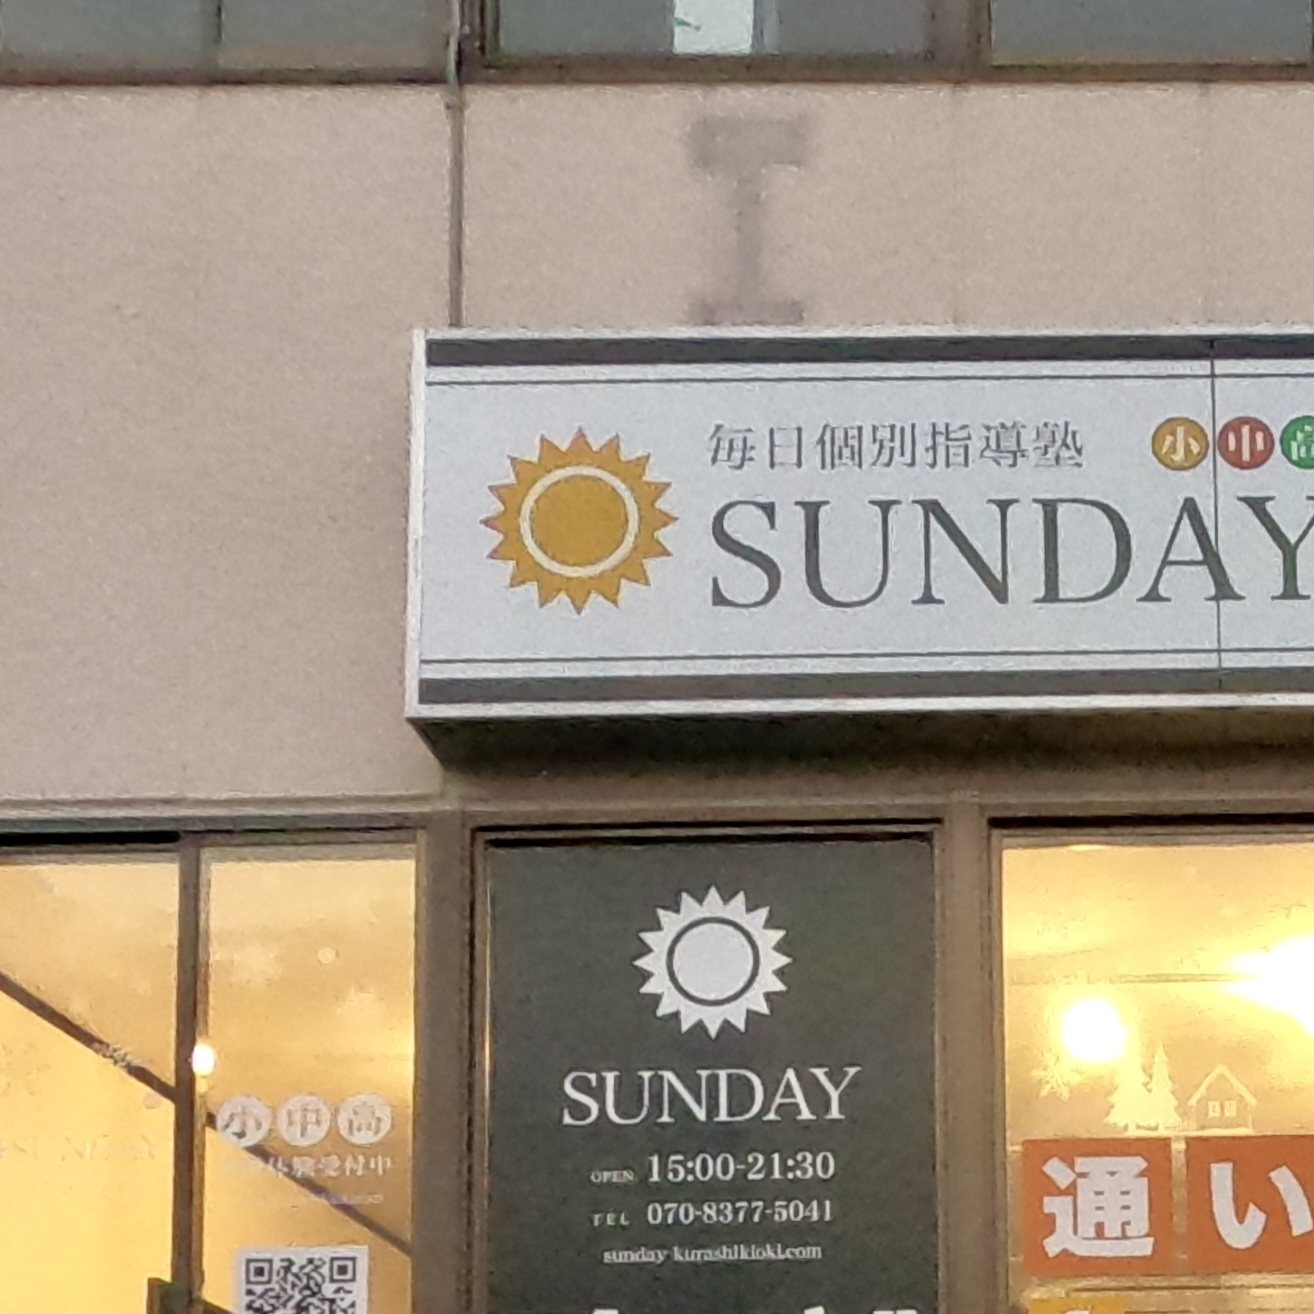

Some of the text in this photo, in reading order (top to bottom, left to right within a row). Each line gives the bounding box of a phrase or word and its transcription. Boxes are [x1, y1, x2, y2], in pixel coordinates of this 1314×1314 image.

[709, 423, 1084, 470] 毎日個別指導塾
[562, 1066, 861, 1127] SUNDAY
[590, 1151, 836, 1183] OPEN 15:00-21:30
[593, 1200, 832, 1227] TEL 070-8377-5041
